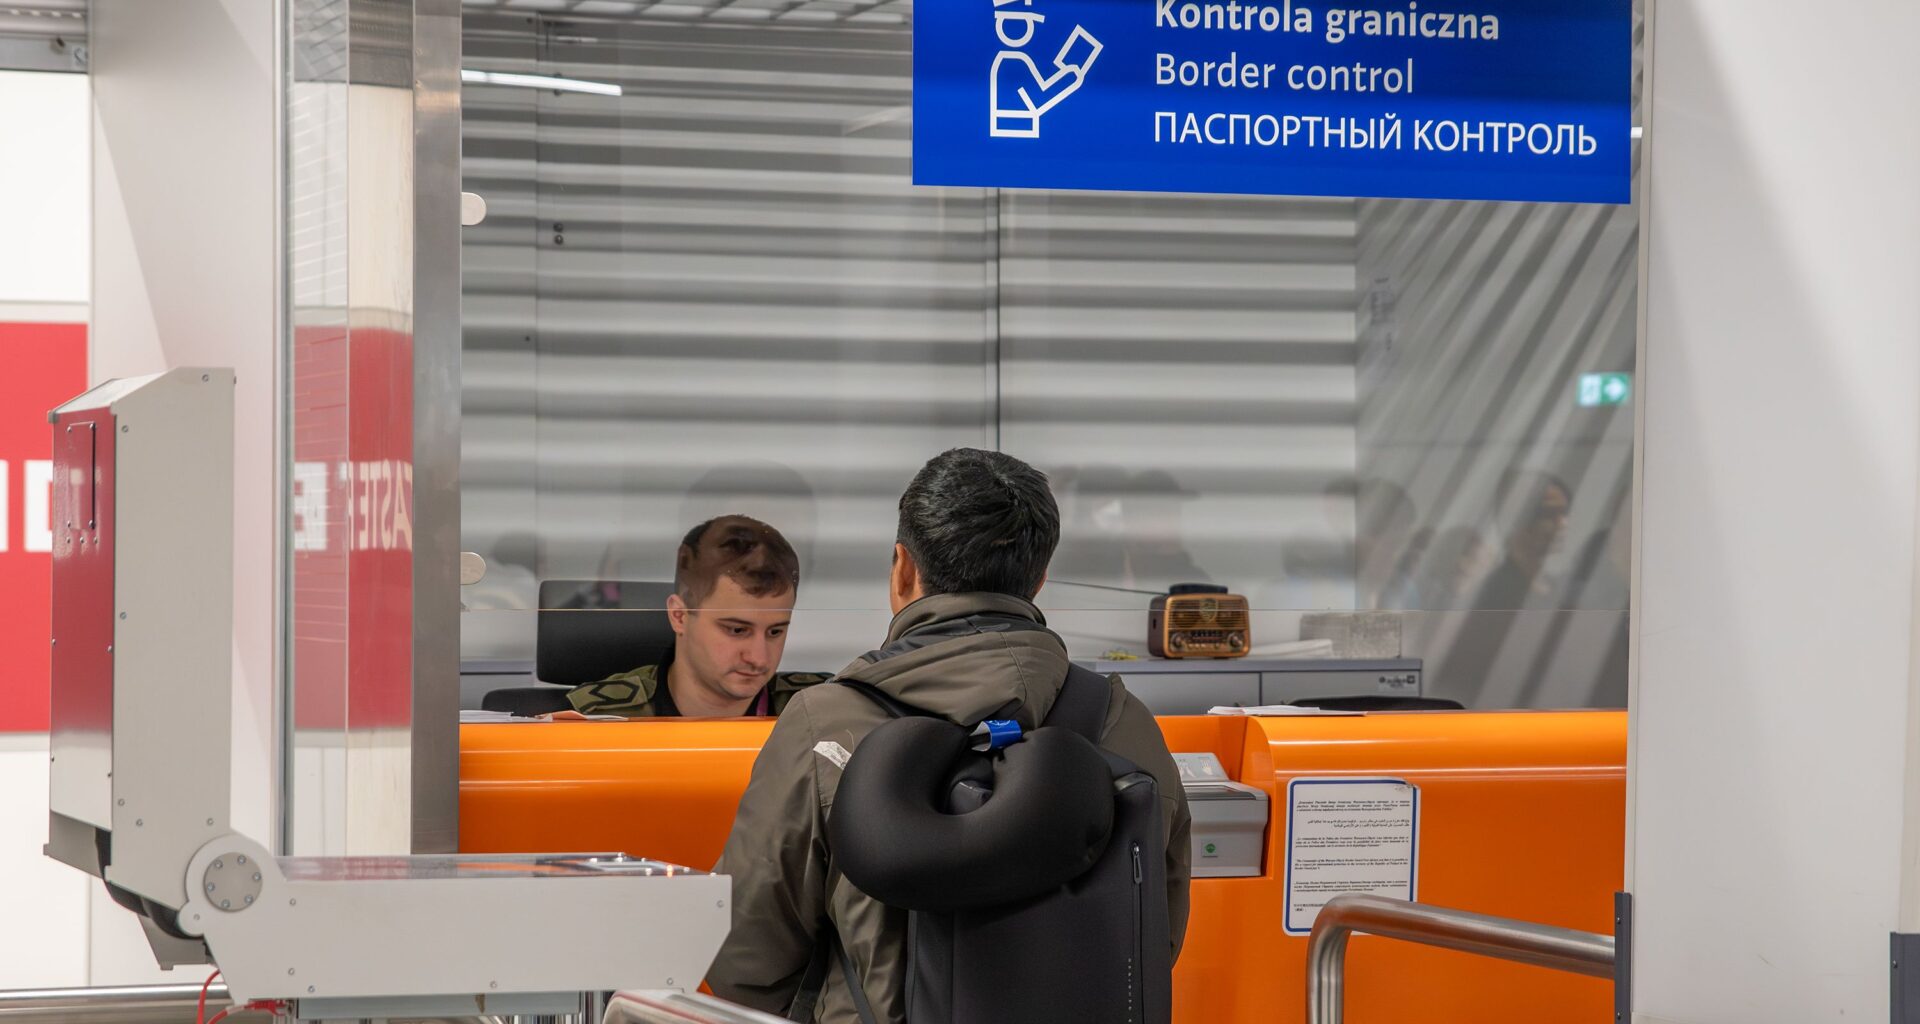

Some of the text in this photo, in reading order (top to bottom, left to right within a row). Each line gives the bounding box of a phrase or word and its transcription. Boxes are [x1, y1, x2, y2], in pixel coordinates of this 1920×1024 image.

[1156, 0, 1499, 45] Kontrola graniczna
[1156, 52, 1414, 93] Border control
[1154, 112, 1597, 156] ПАСПОРТНЫЙ КОНТРОЛЬ
